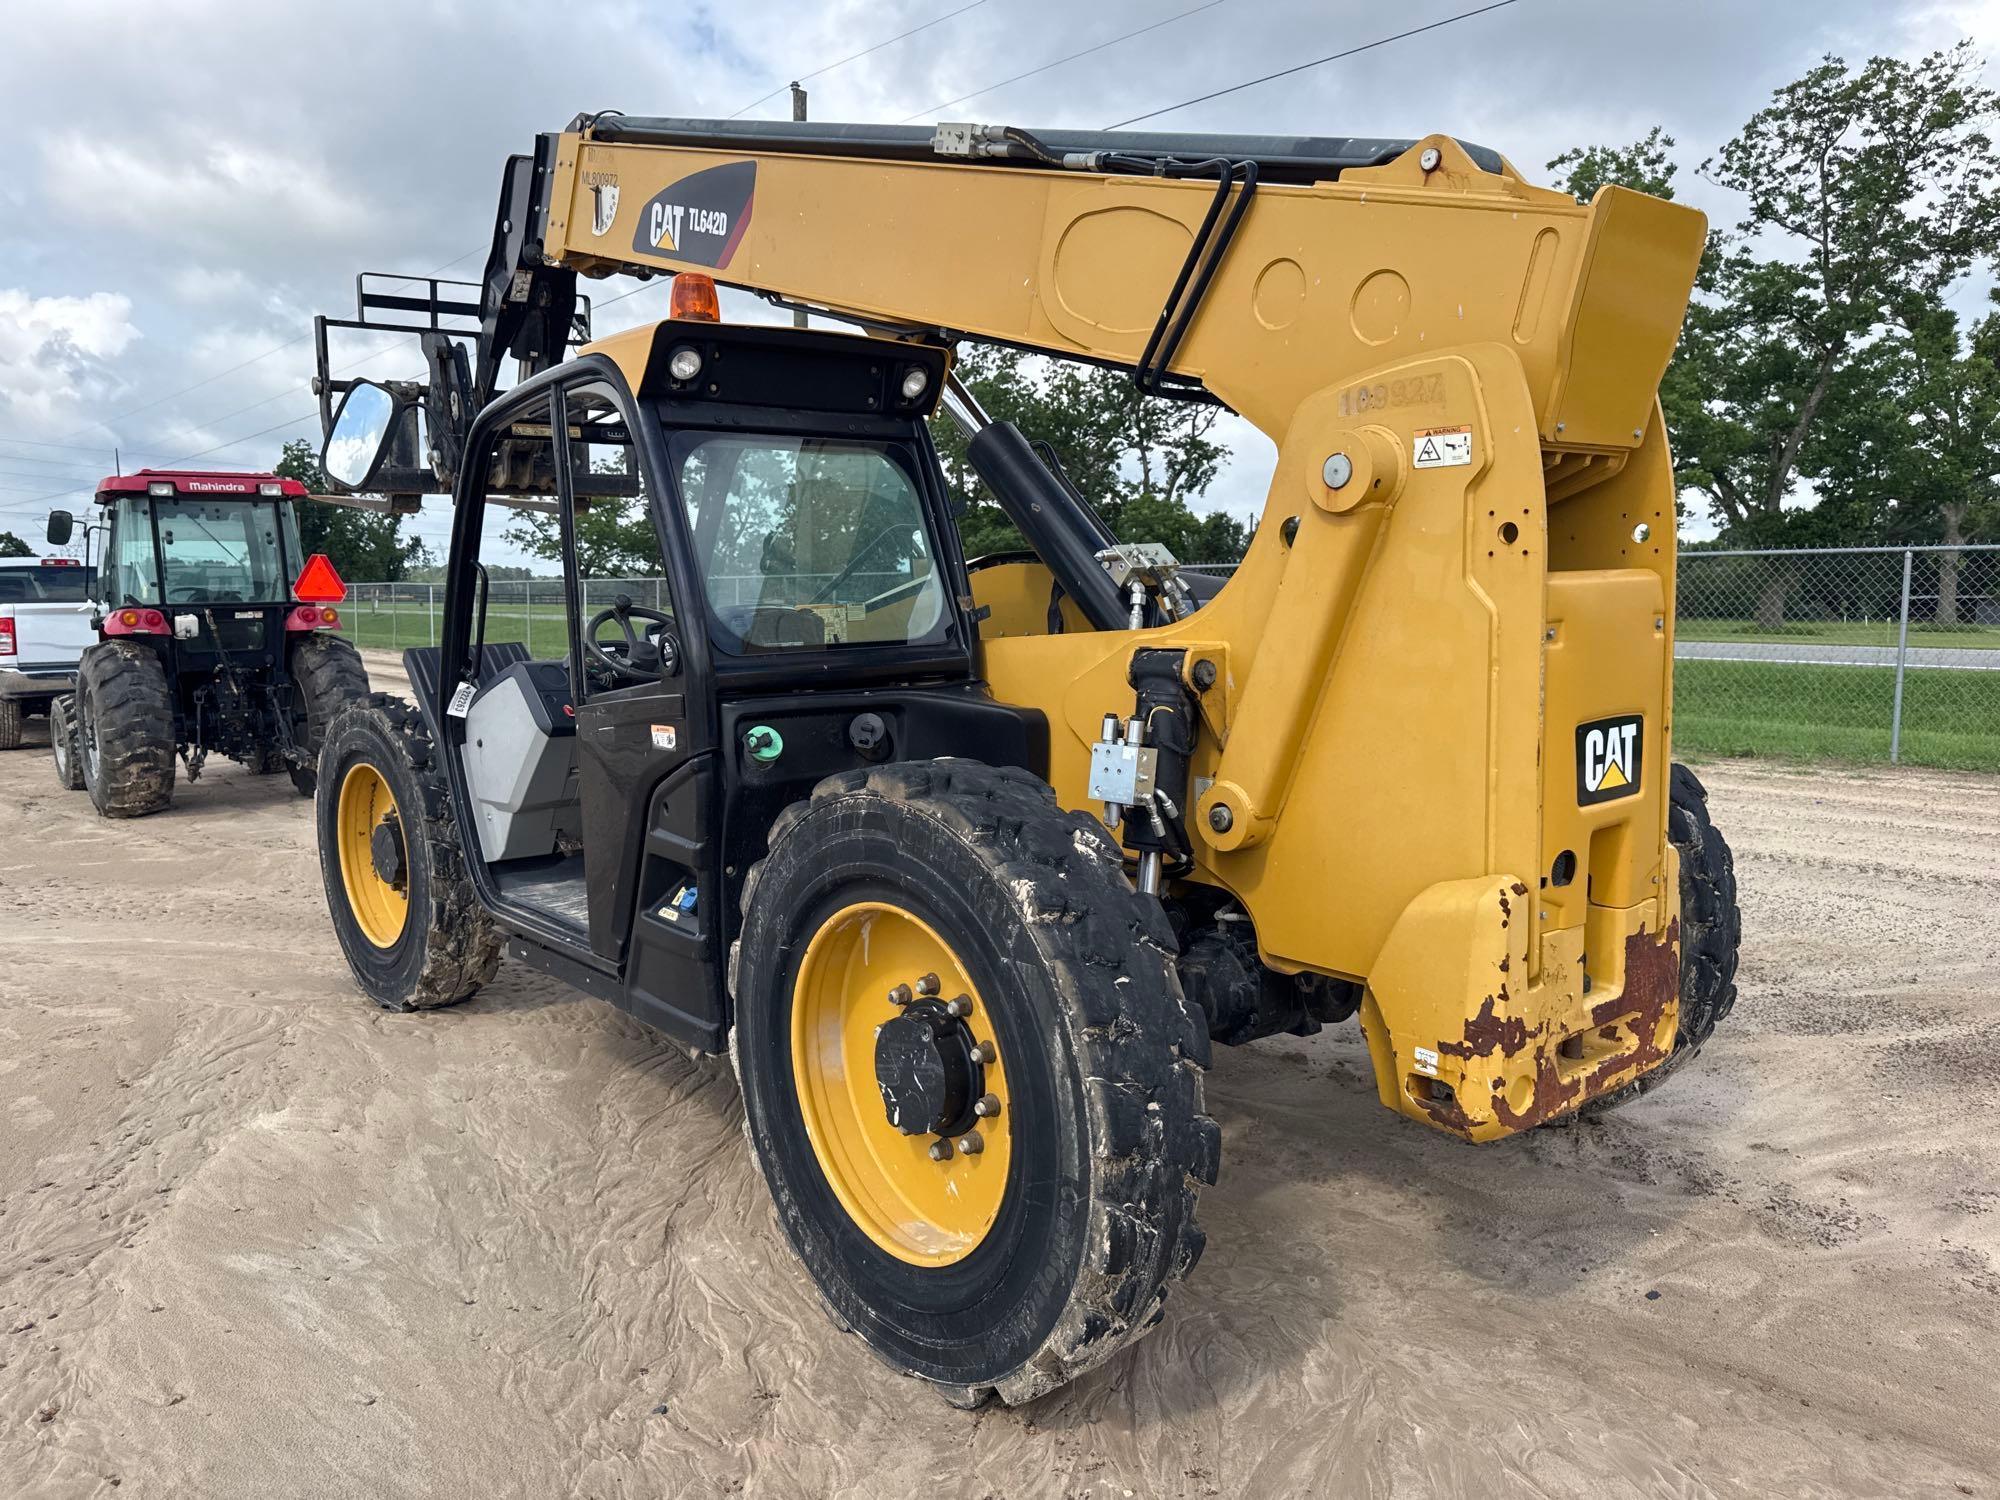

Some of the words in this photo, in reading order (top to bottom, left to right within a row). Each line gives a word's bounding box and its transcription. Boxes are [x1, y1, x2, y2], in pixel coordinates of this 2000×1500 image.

[650, 202, 684, 251] CAT
[689, 207, 727, 236] TL642D
[1433, 427, 1461, 436] WARNING
[189, 482, 245, 491] Mahindra
[1585, 723, 1637, 792] CAT
